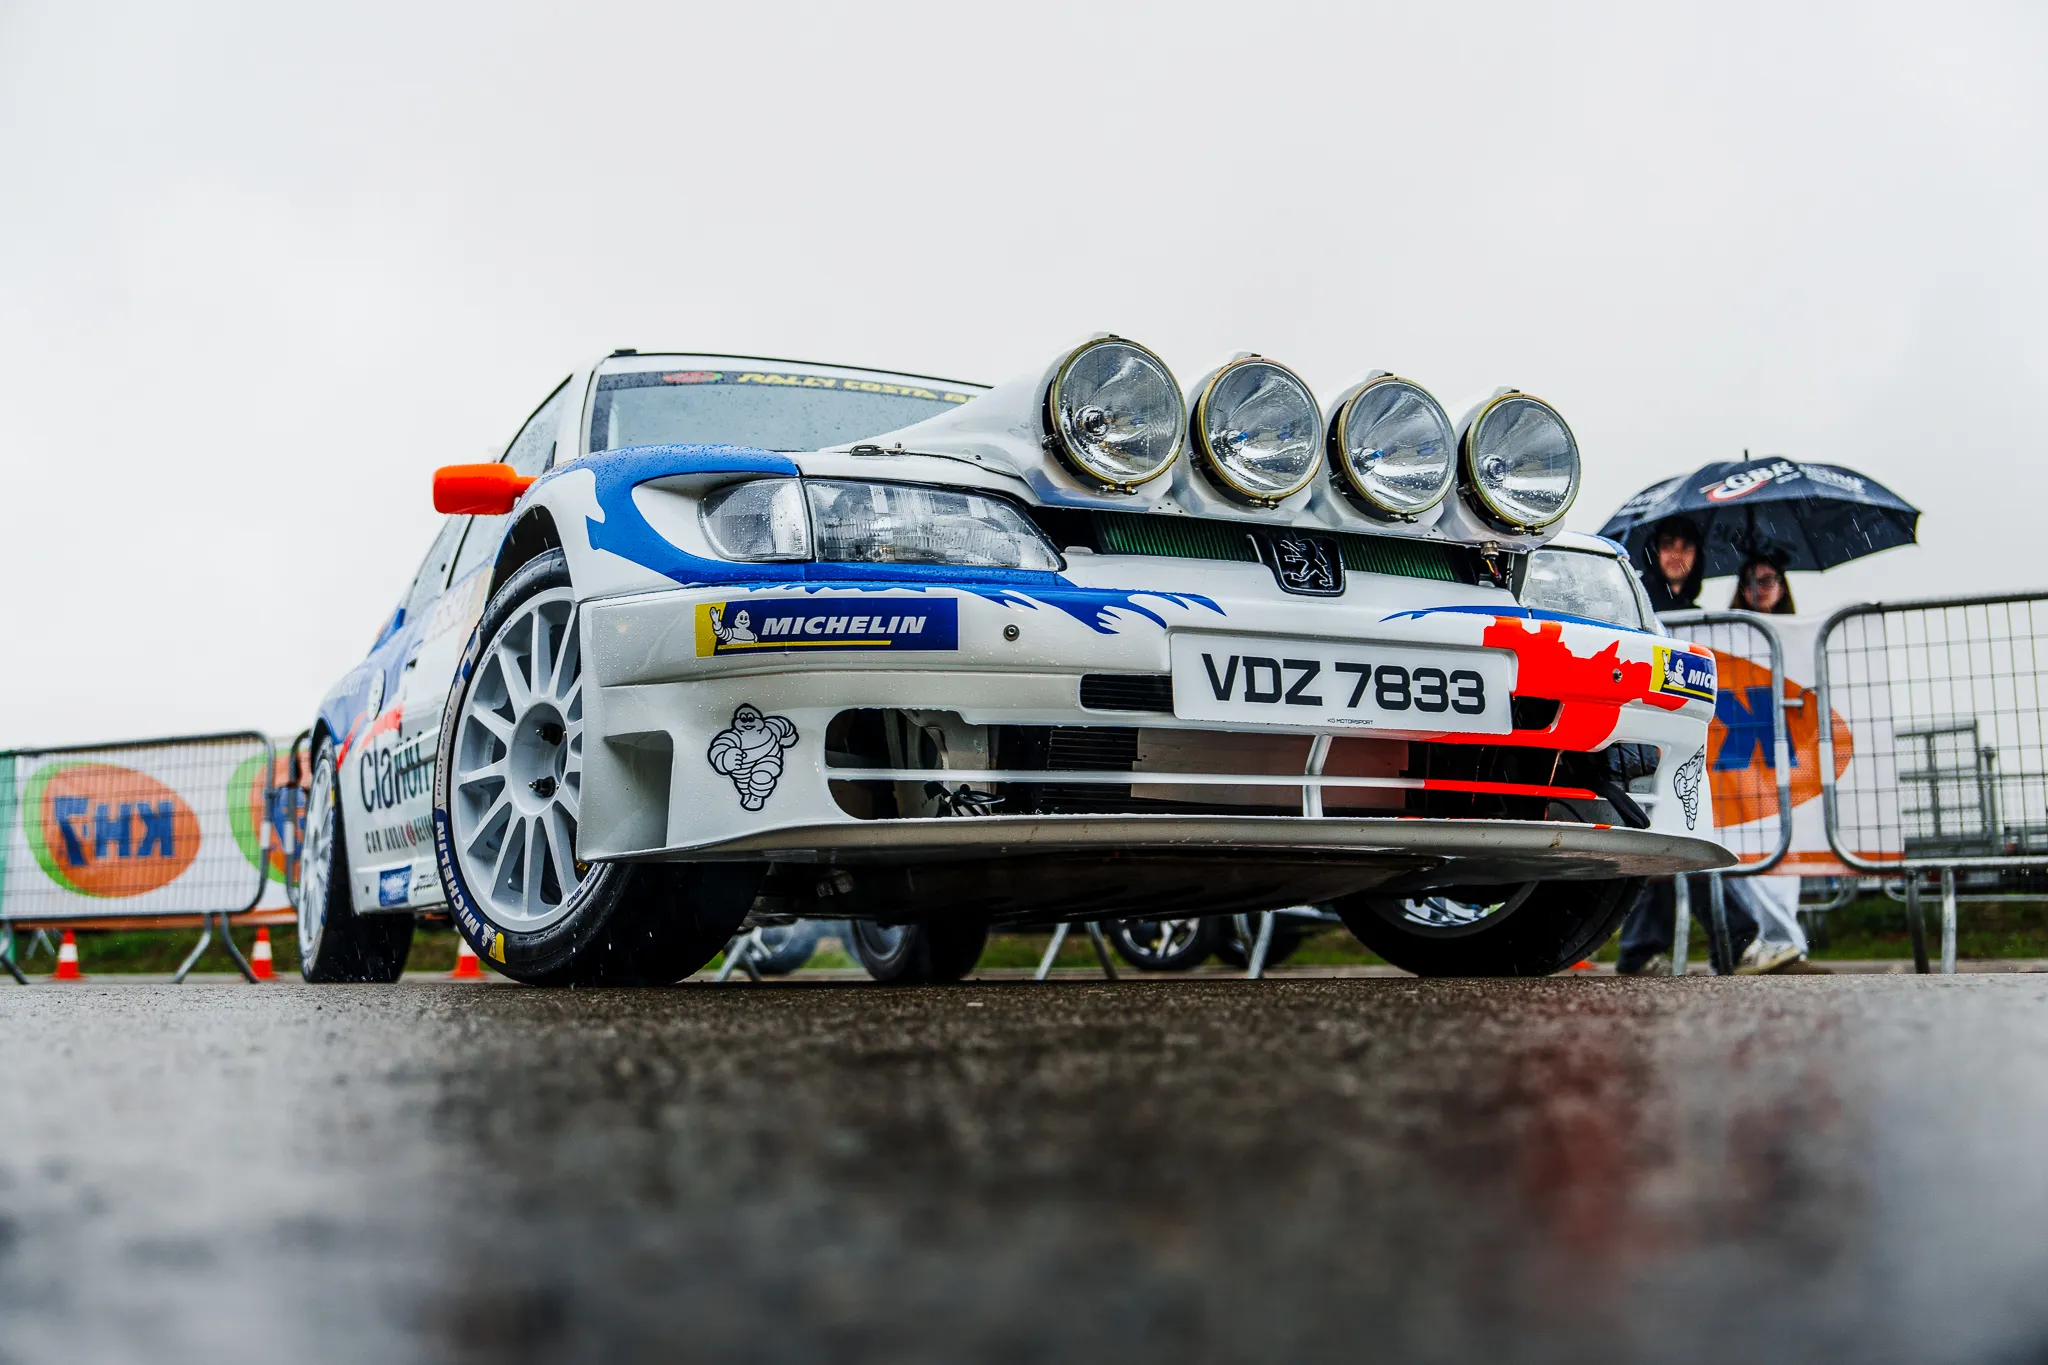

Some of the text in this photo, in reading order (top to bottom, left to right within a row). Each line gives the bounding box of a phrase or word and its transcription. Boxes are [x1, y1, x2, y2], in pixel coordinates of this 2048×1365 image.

[737, 373, 837, 387] RALLY
[843, 380, 938, 400] COSTA
[1725, 460, 1795, 490] GBR
[761, 616, 927, 636] MICHELIN
[1201, 653, 1487, 716] VDZ 7833
[441, 704, 453, 753] SPORT
[436, 821, 481, 937] MICHELIN
